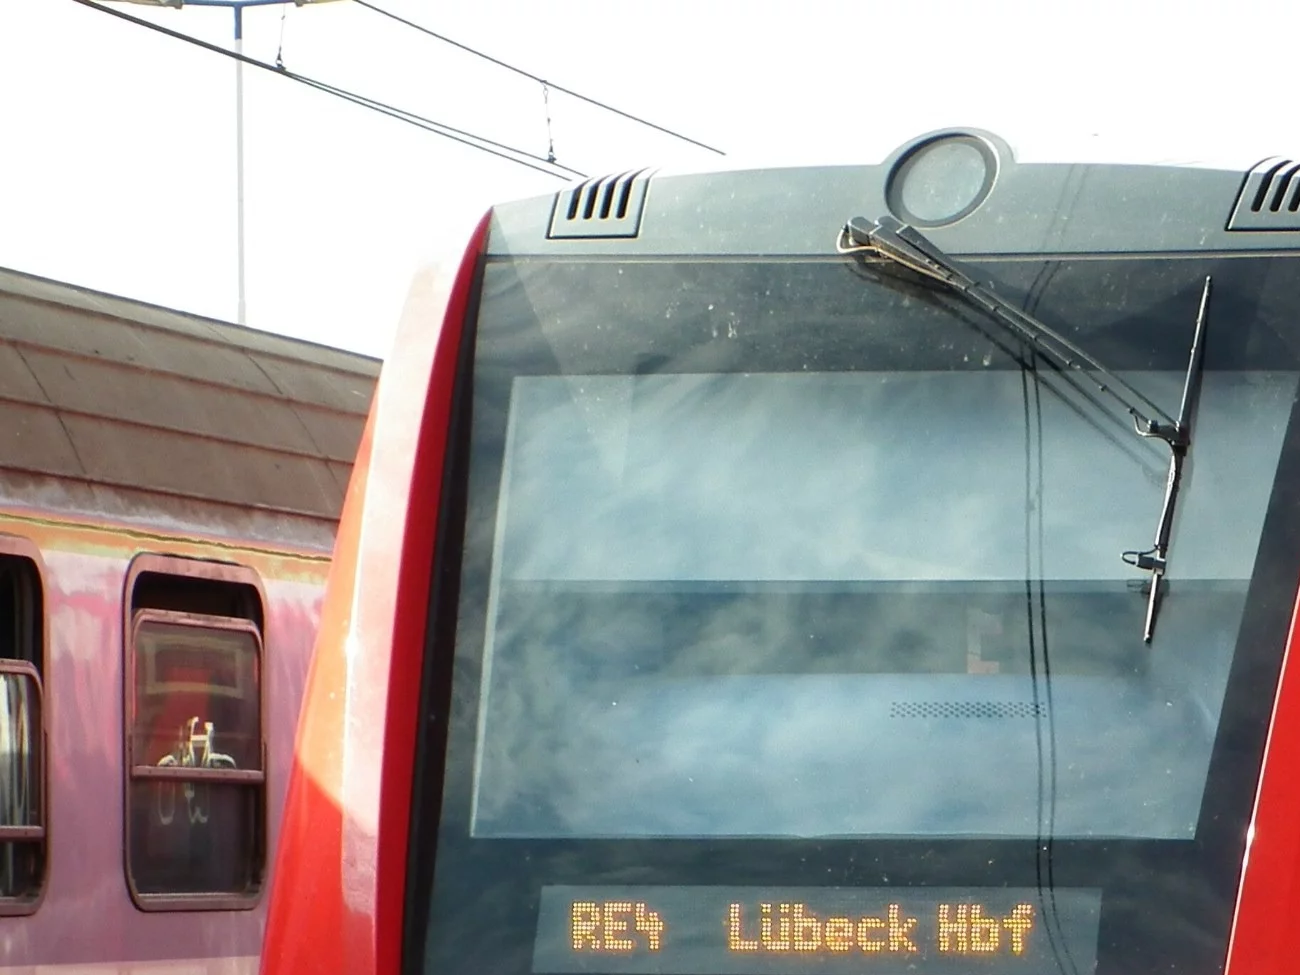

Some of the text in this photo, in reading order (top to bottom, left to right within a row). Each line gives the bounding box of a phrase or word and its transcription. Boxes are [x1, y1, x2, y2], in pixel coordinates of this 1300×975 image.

[570, 902, 1034, 954] RE4 Lübeck Hbf
